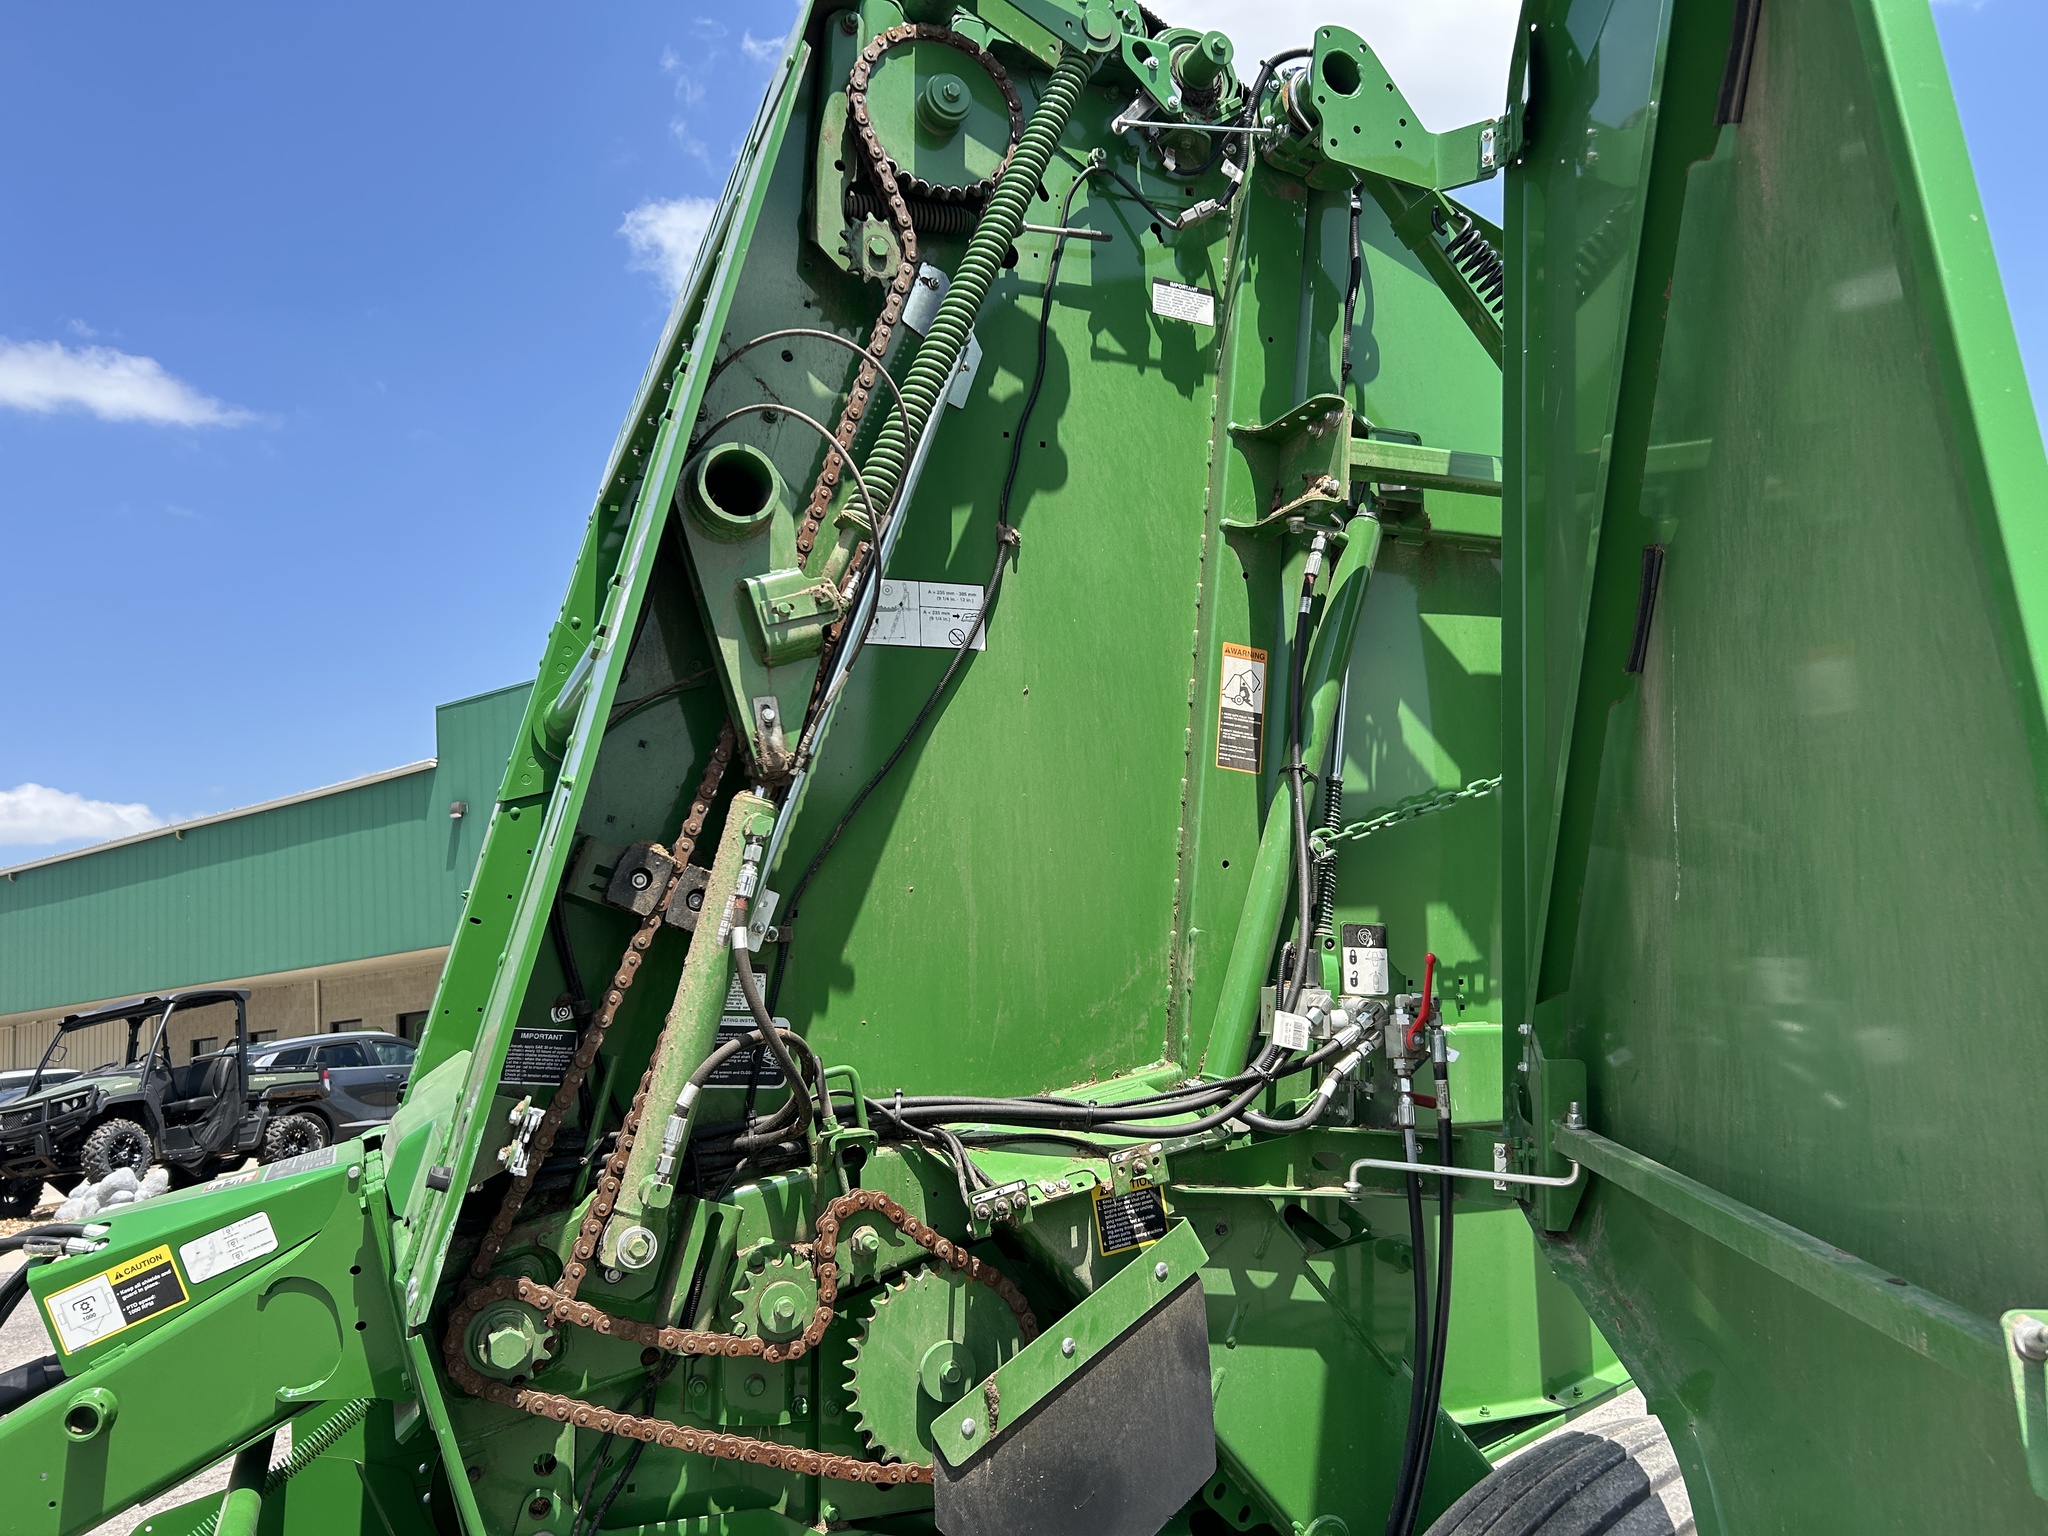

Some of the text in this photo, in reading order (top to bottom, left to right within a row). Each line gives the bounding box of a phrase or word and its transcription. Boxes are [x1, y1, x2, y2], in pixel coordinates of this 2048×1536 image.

[1169, 281, 1199, 293] IMPORTANT
[1230, 647, 1265, 660] WARNING
[520, 1032, 563, 1040] IMPORTANT
[123, 1253, 163, 1275] CAUTION
[120, 1286, 134, 1295] Keep
[141, 1273, 161, 1286] shields
[160, 1268, 172, 1278] and
[121, 1290, 138, 1302] guard
[143, 1280, 160, 1292] place.
[125, 1294, 156, 1311] PTO speed:
[127, 1300, 155, 1316] 1000 RPM
[82, 1312, 97, 1322] 1000
